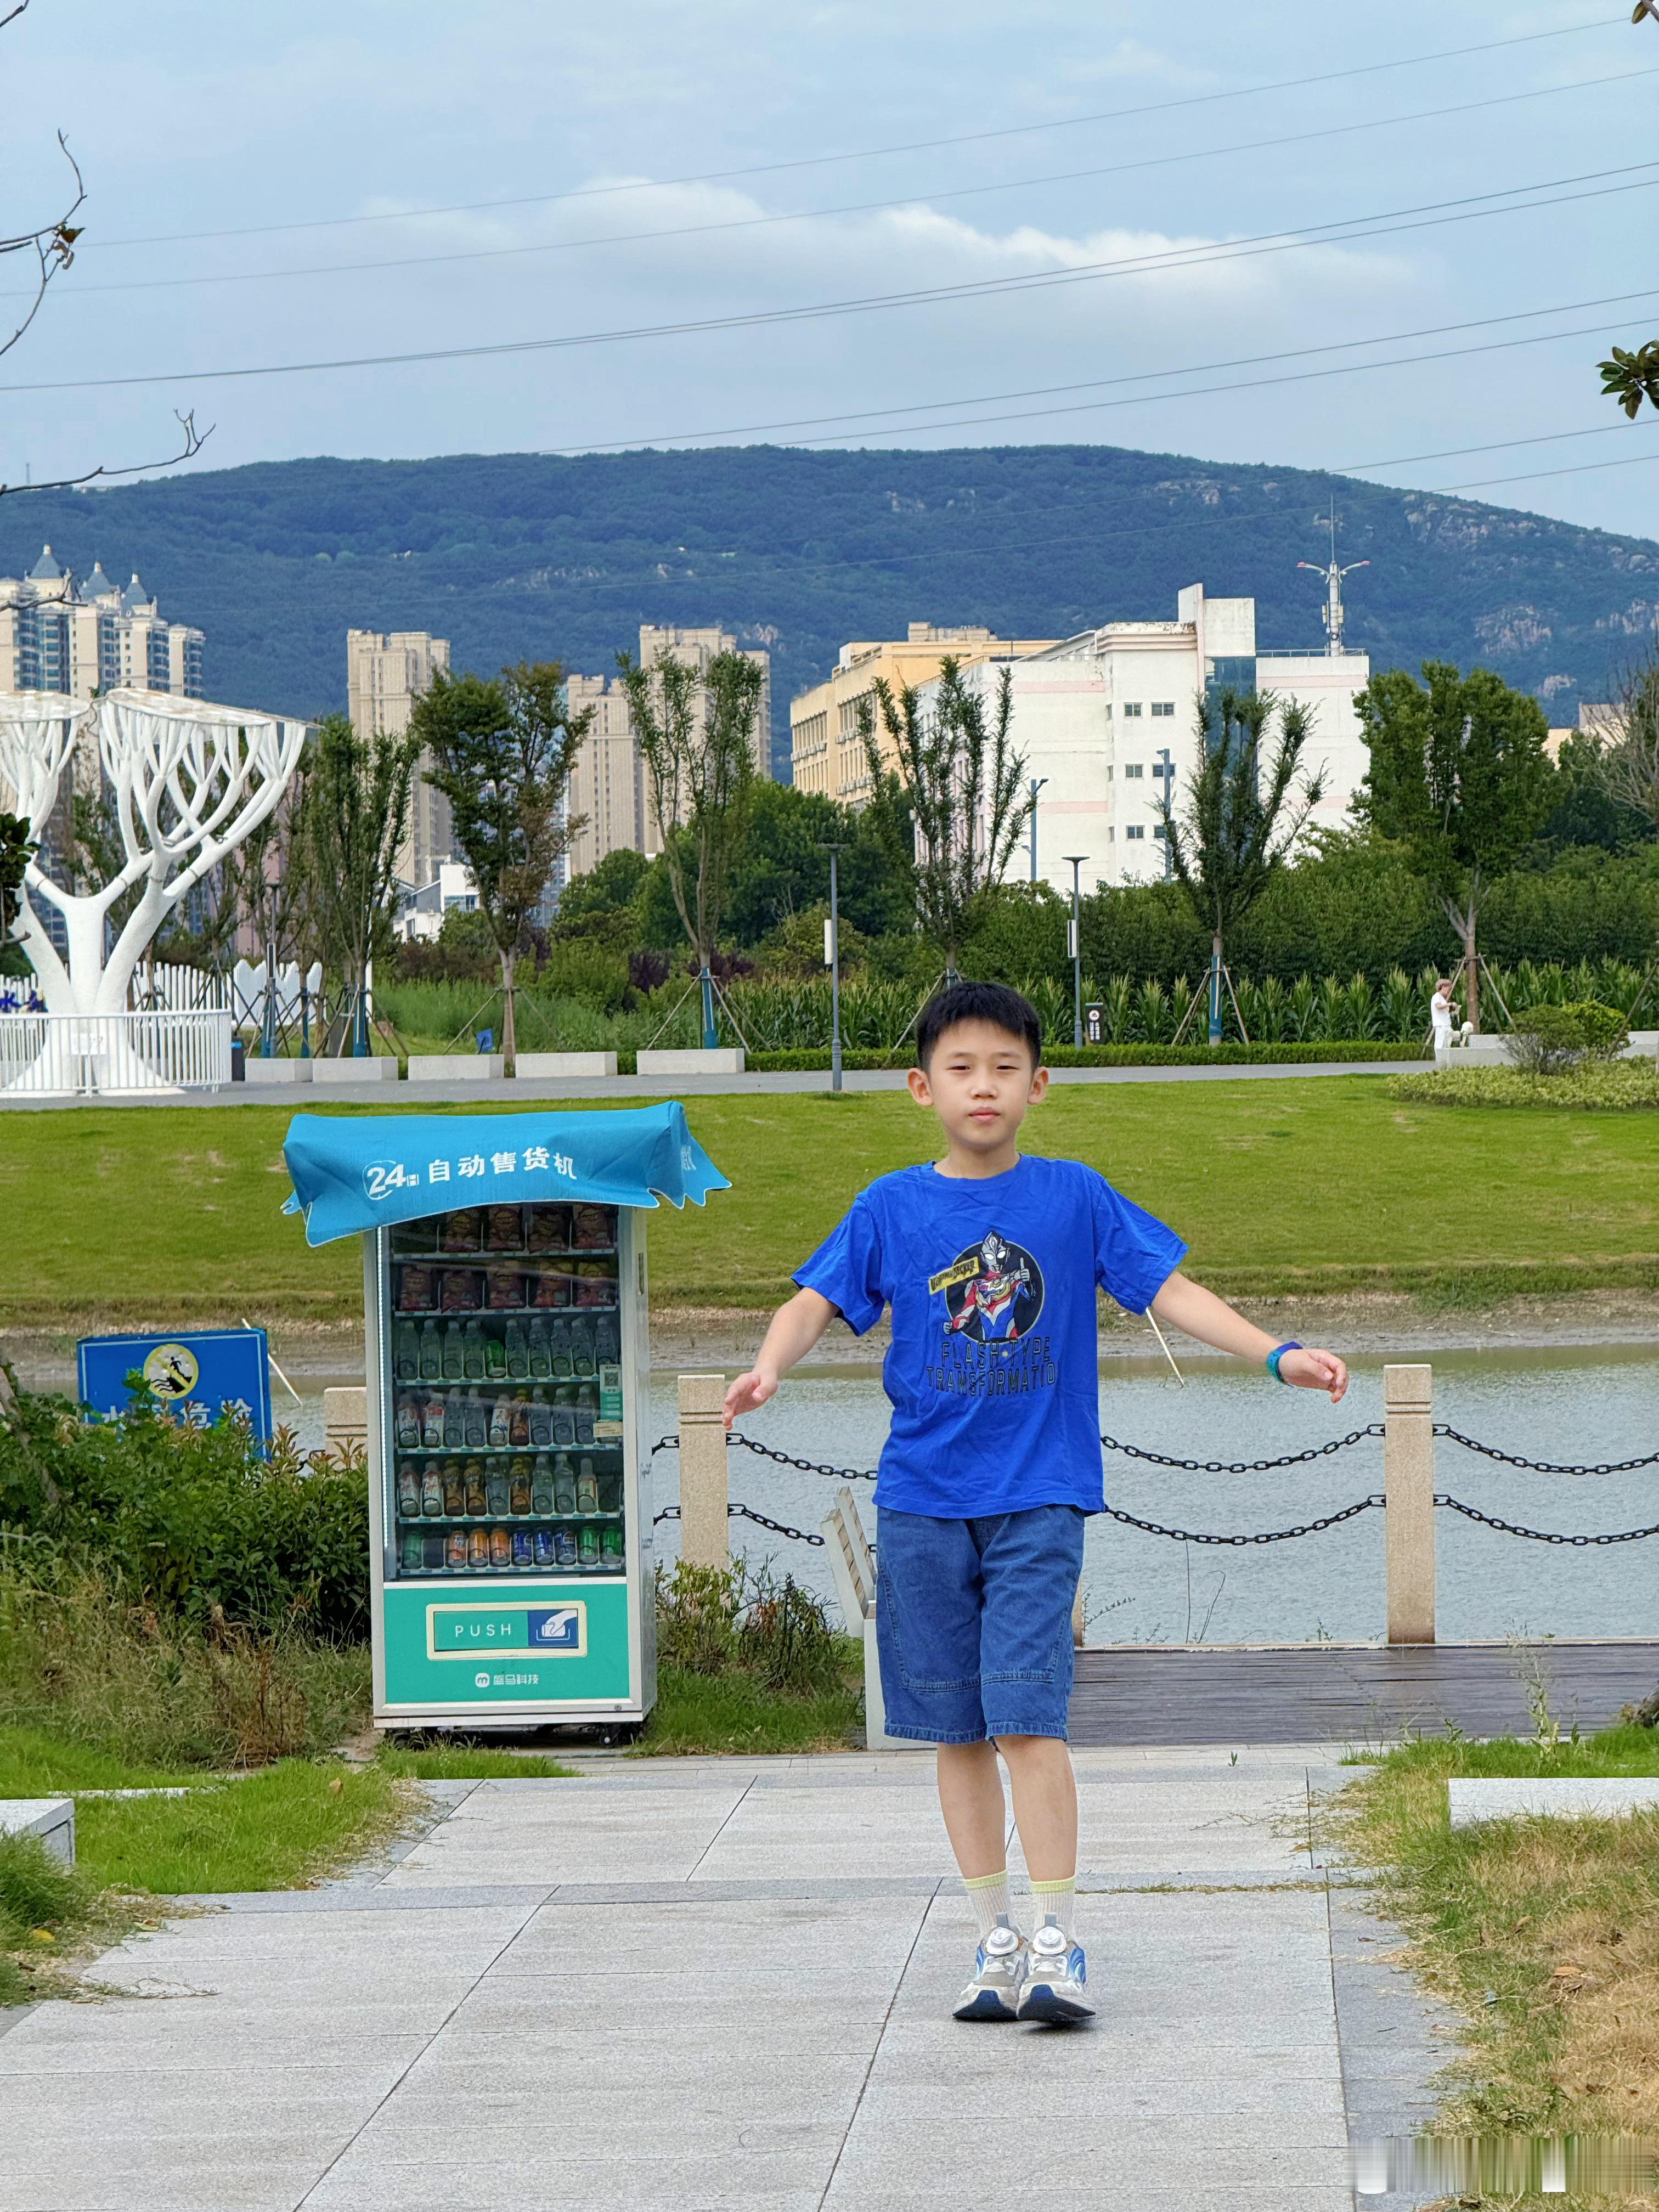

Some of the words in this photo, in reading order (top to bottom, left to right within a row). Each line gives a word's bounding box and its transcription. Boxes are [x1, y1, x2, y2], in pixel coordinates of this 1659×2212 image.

[428, 1147, 577, 1184] 自动售货机
[941, 1340, 1000, 1369] FLASH
[1009, 1337, 1051, 1367] TYPE
[455, 1624, 511, 1637] PUSH
